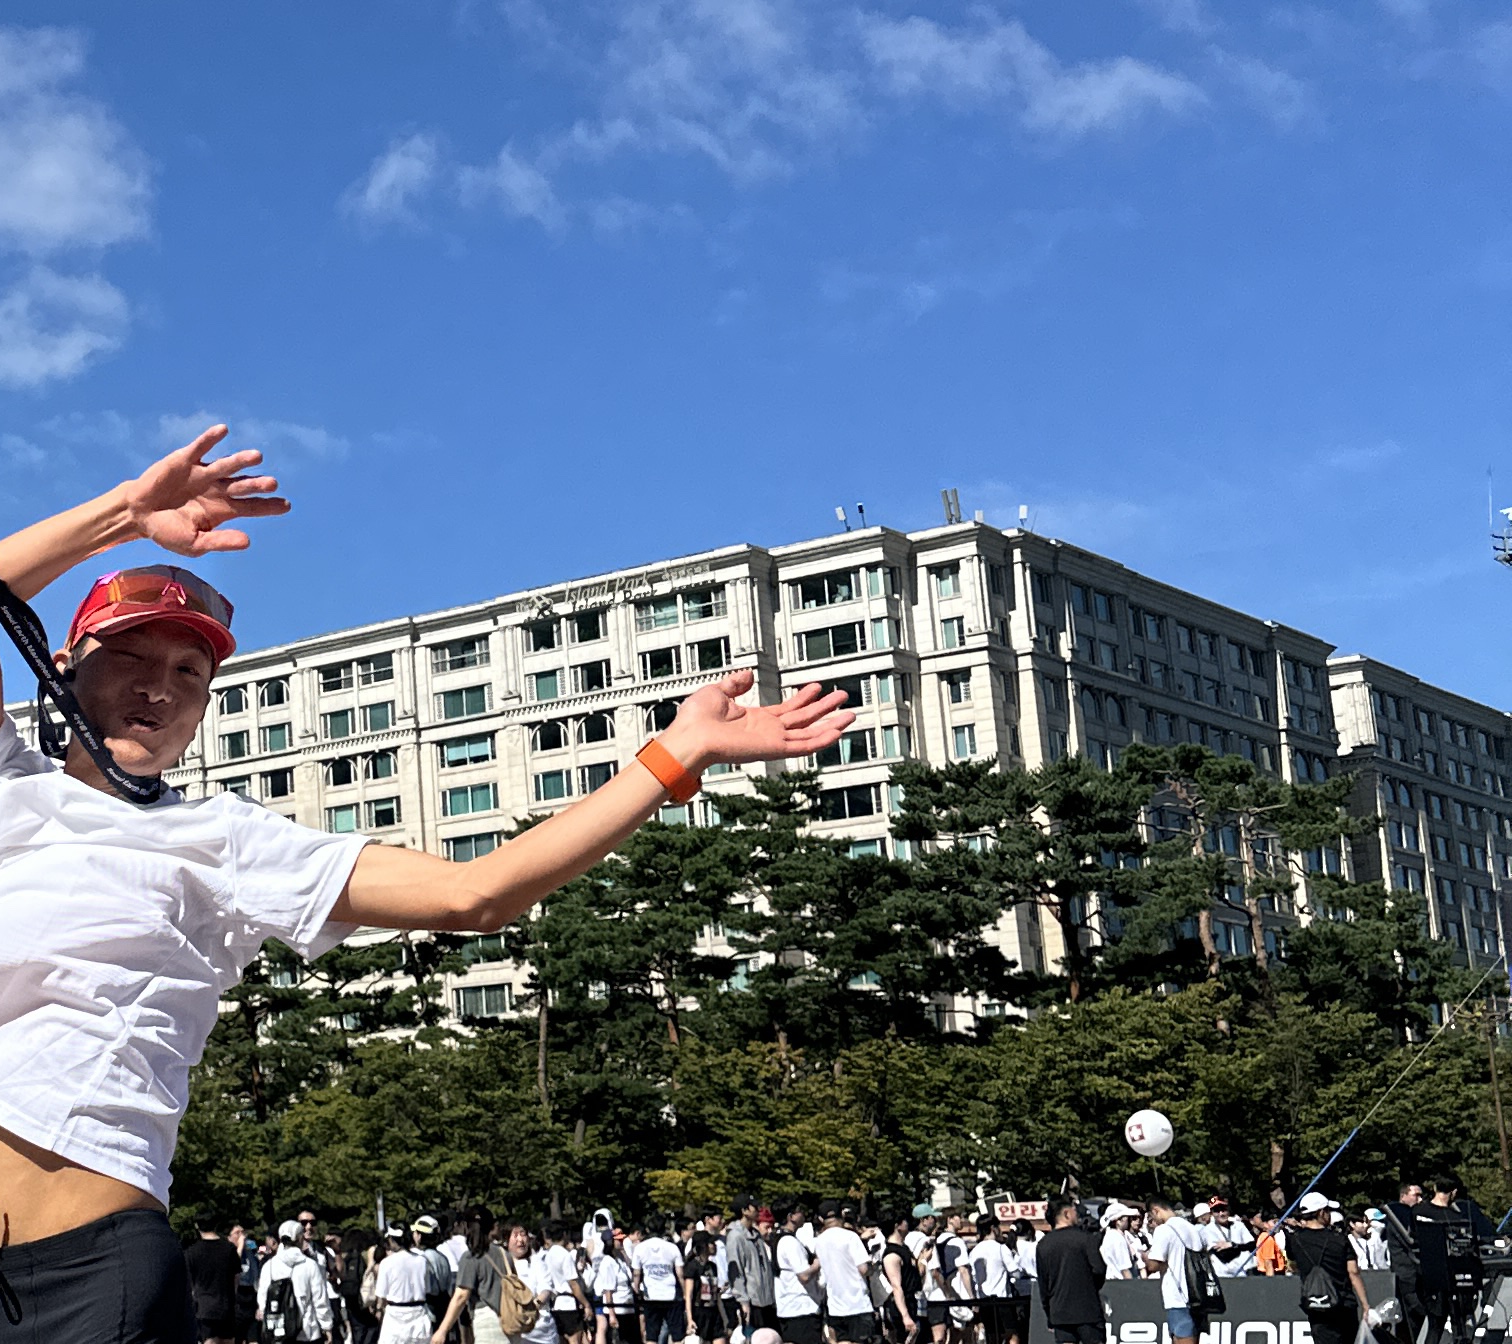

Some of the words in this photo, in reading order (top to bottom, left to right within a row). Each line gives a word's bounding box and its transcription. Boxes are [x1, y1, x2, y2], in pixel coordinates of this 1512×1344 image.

[564, 580, 609, 604] Island
[615, 570, 650, 595] Park
[26, 644, 52, 679] Marathon
[998, 1204, 1048, 1218] 인라
